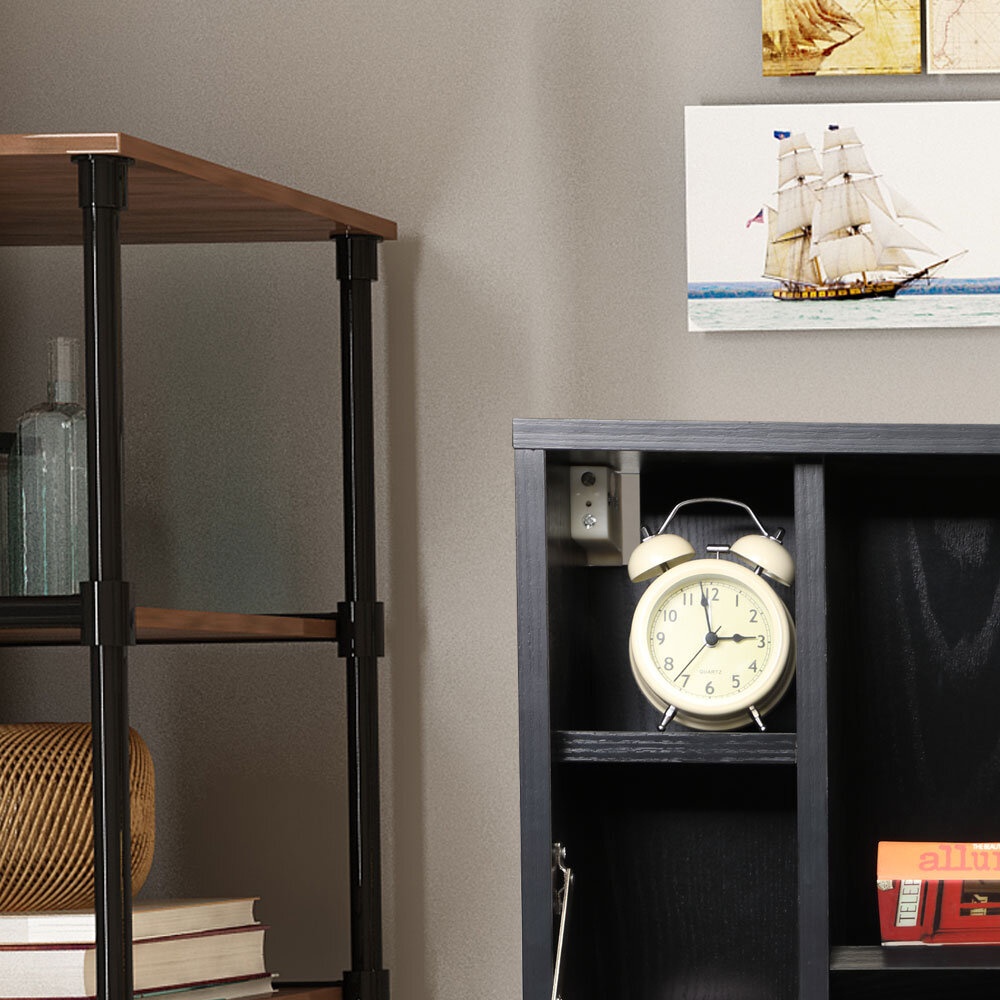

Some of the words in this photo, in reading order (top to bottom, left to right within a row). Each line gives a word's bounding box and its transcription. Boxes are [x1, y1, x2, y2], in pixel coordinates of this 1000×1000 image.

[683, 593, 693, 606] 11
[705, 587, 719, 601] 12
[663, 609, 677, 622] 10
[749, 609, 758, 623] 2
[656, 632, 665, 645] 9
[757, 635, 766, 648] 3
[664, 657, 674, 671] 8
[748, 660, 757, 673] 4
[681, 674, 690, 688] 7
[705, 681, 715, 694] 6
[732, 675, 740, 688] 5
